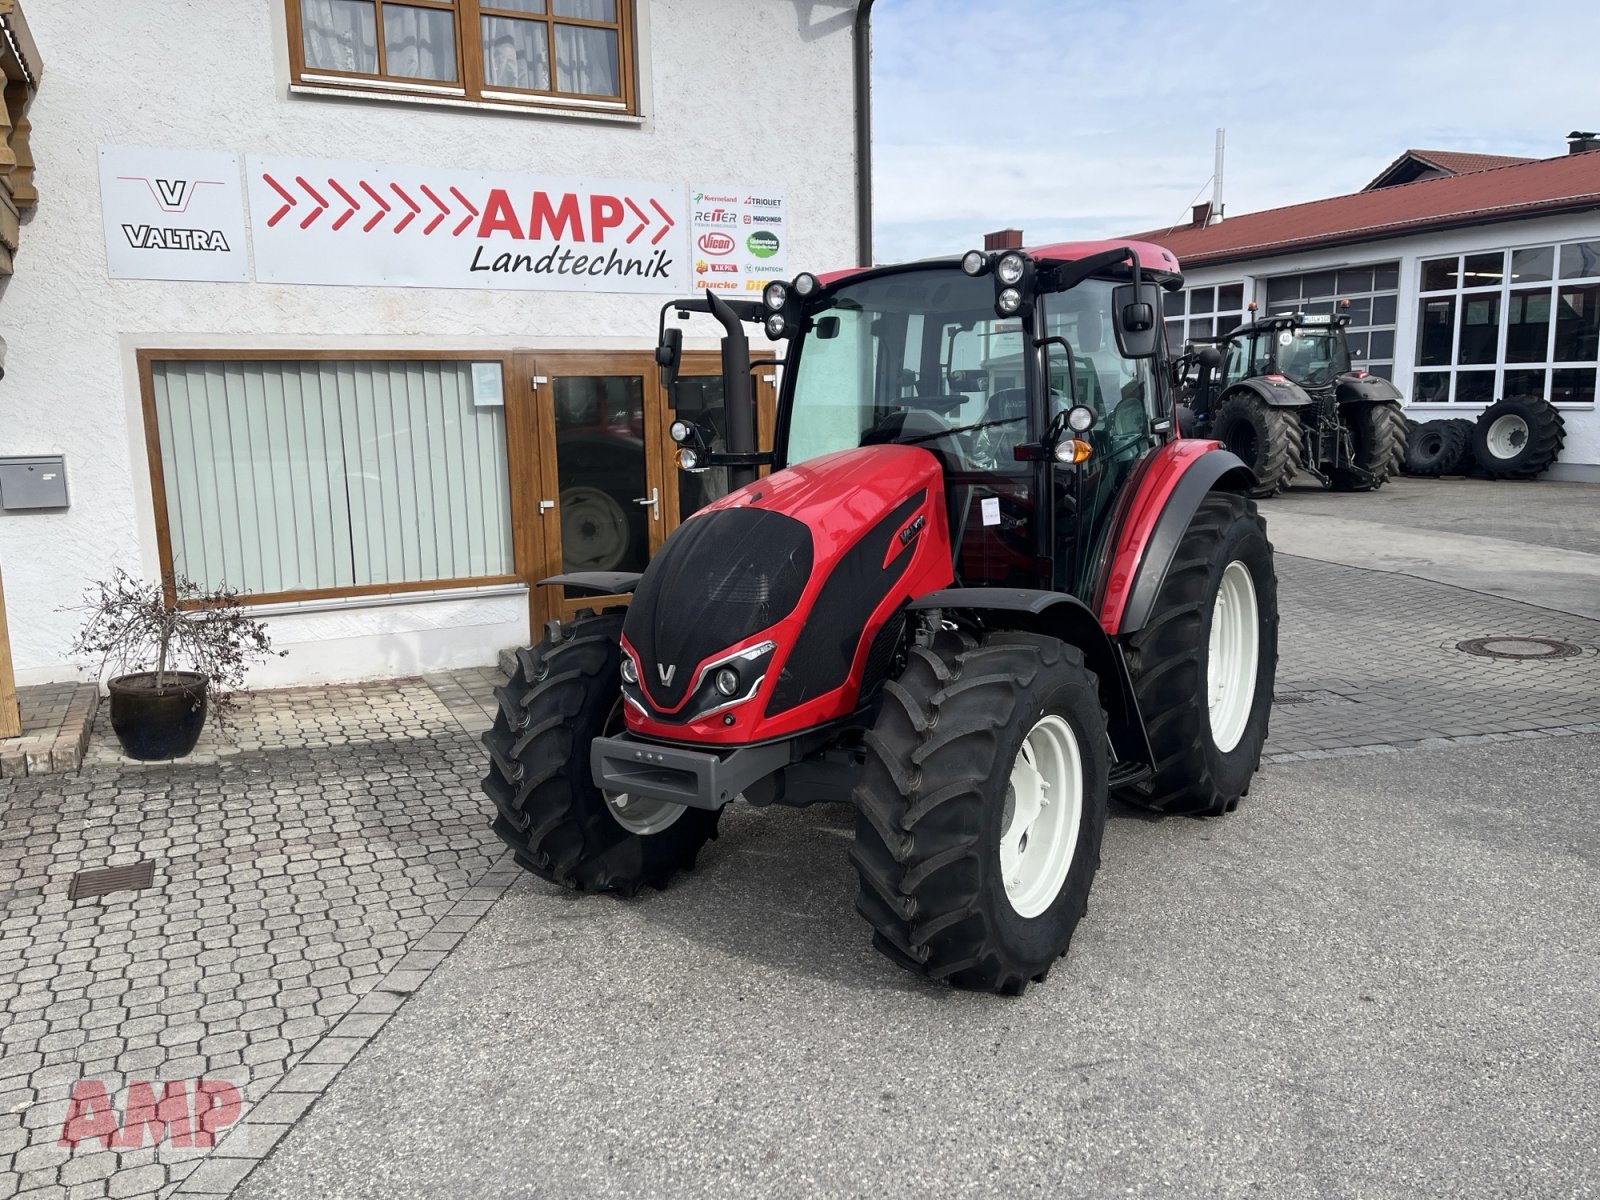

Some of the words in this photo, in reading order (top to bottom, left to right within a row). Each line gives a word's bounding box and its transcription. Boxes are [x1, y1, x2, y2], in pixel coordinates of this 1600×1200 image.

[156, 179, 186, 206] V
[477, 189, 624, 243] AMP
[695, 209, 737, 222] REITER
[121, 224, 230, 252] VALTRA
[703, 234, 730, 249] Vicon
[470, 244, 673, 278] Landtechnik
[697, 280, 738, 289] Quicke
